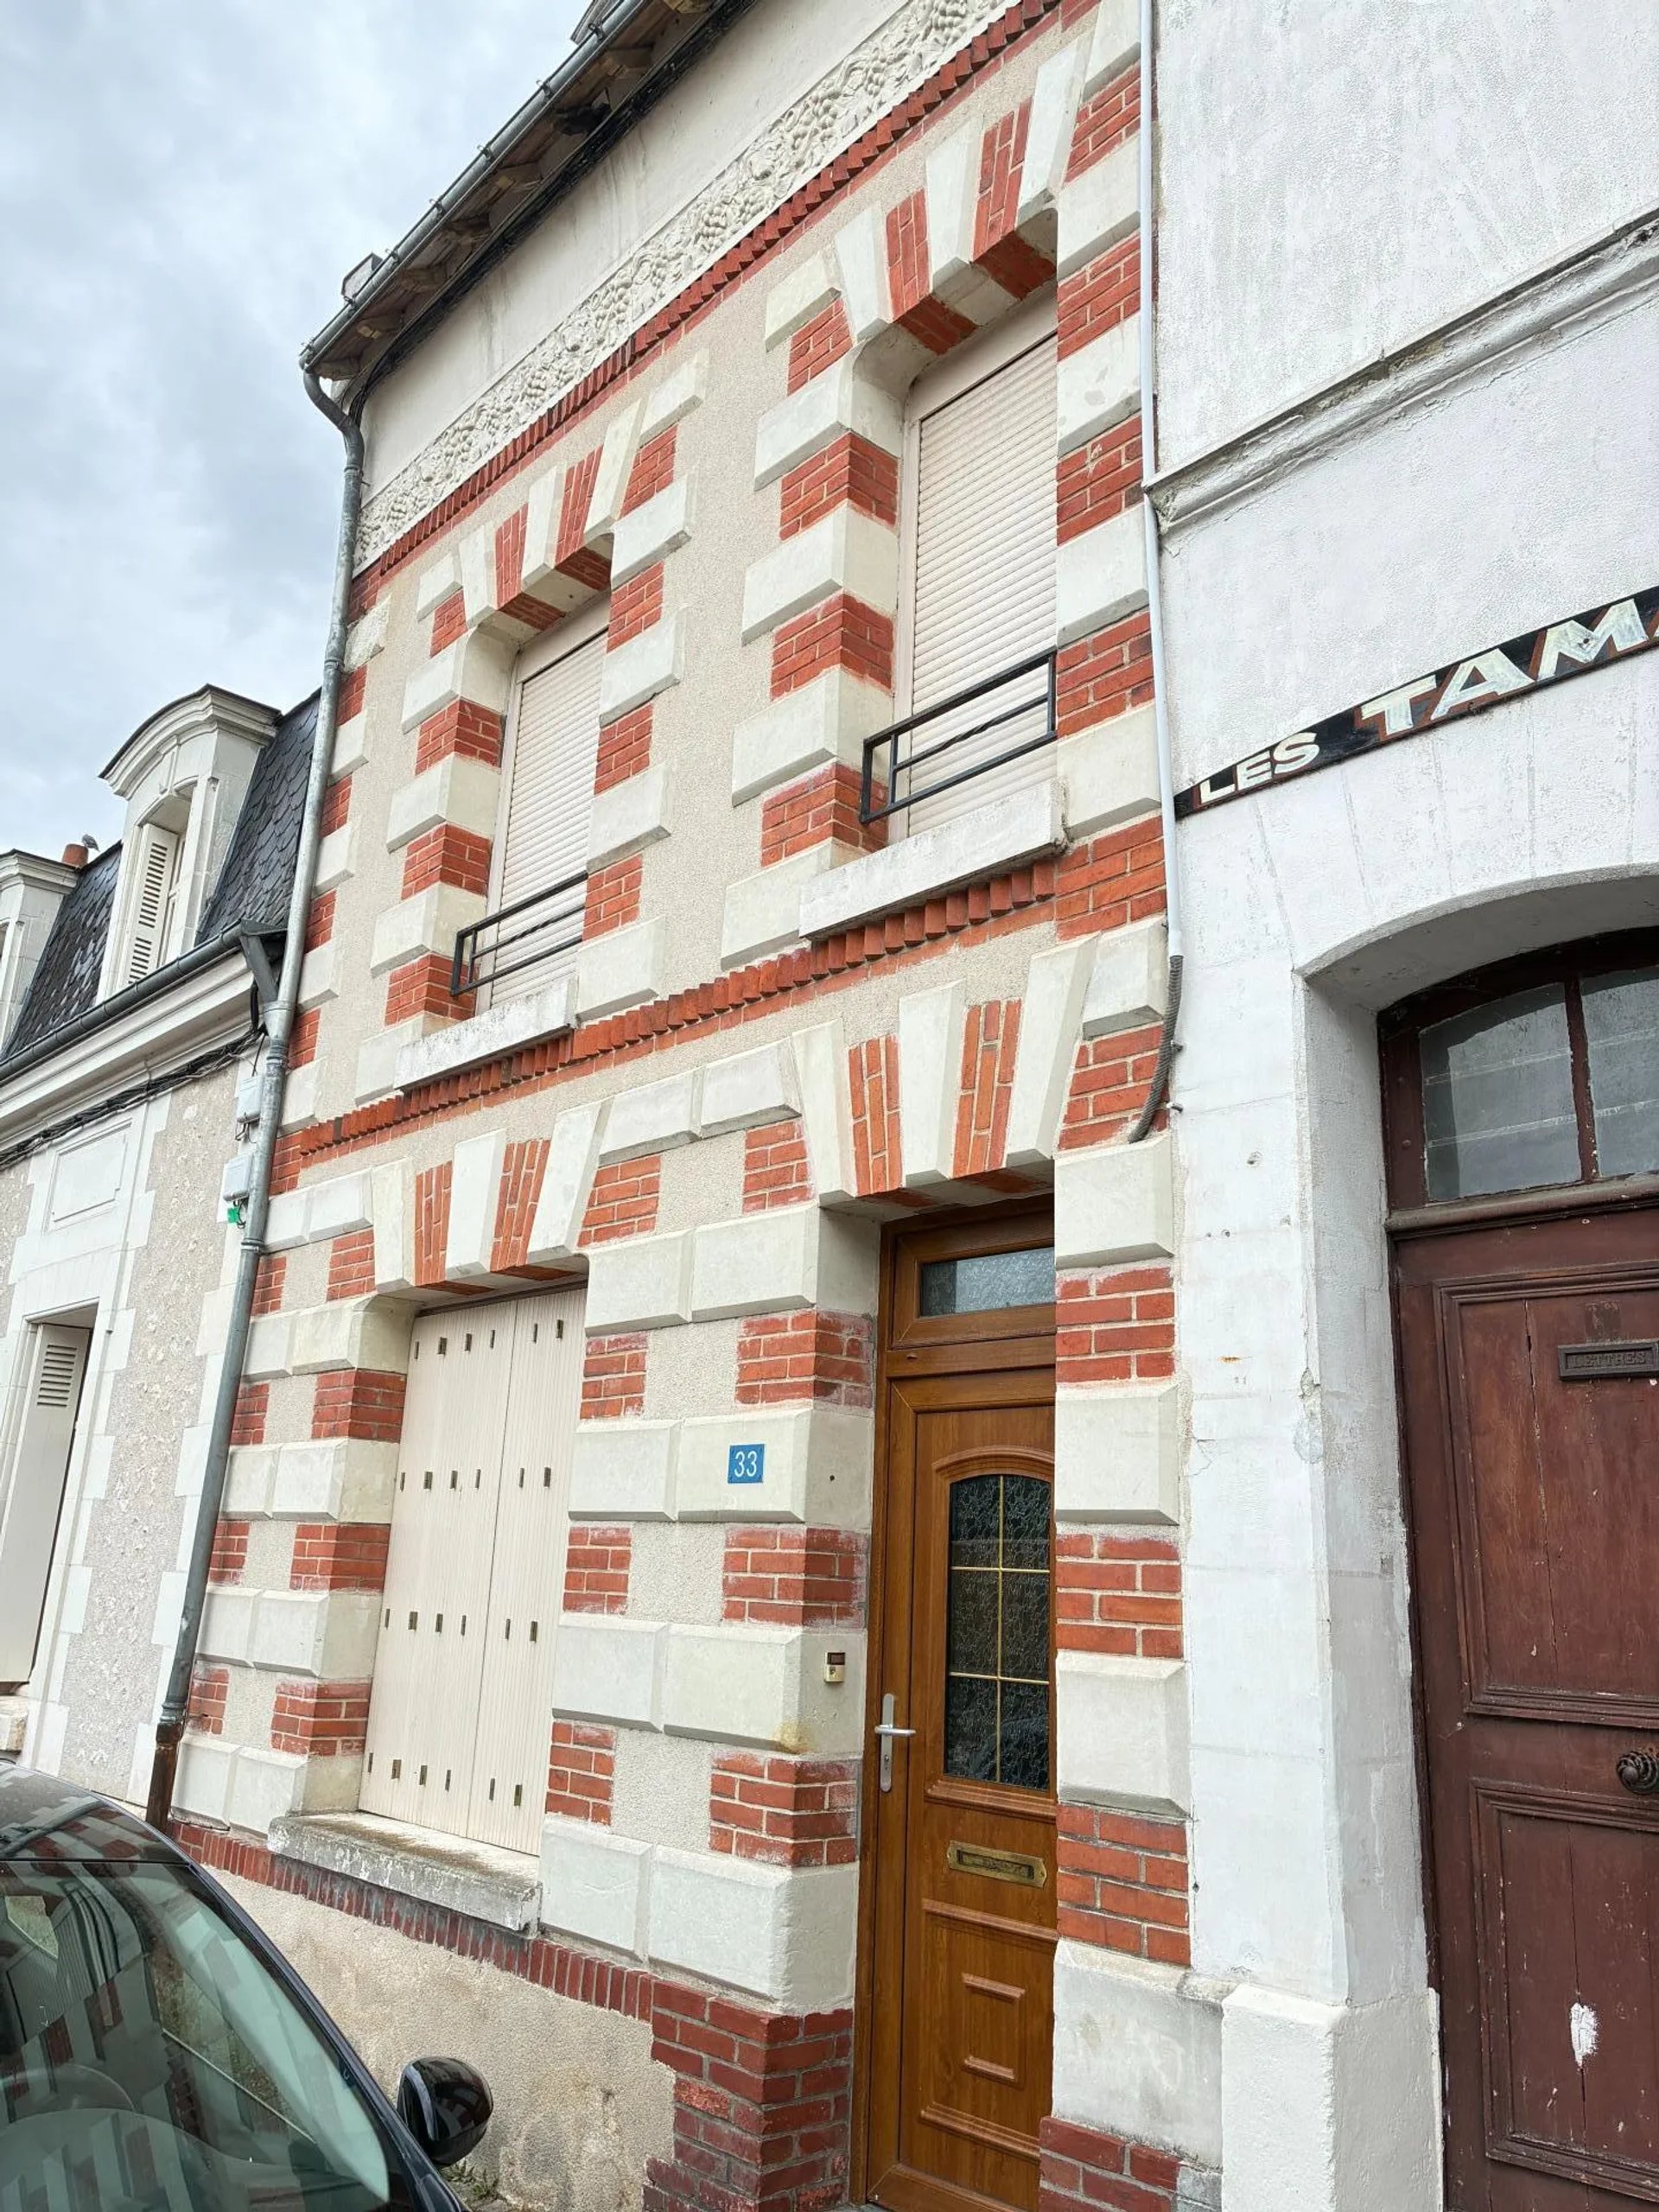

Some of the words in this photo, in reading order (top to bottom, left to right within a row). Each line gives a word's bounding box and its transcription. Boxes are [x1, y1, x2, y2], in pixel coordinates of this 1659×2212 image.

[1198, 731, 1321, 804] LES
[1360, 597, 1659, 735] TAM
[1567, 1350, 1647, 1369] LETTRES
[734, 1450, 758, 1478] 33
